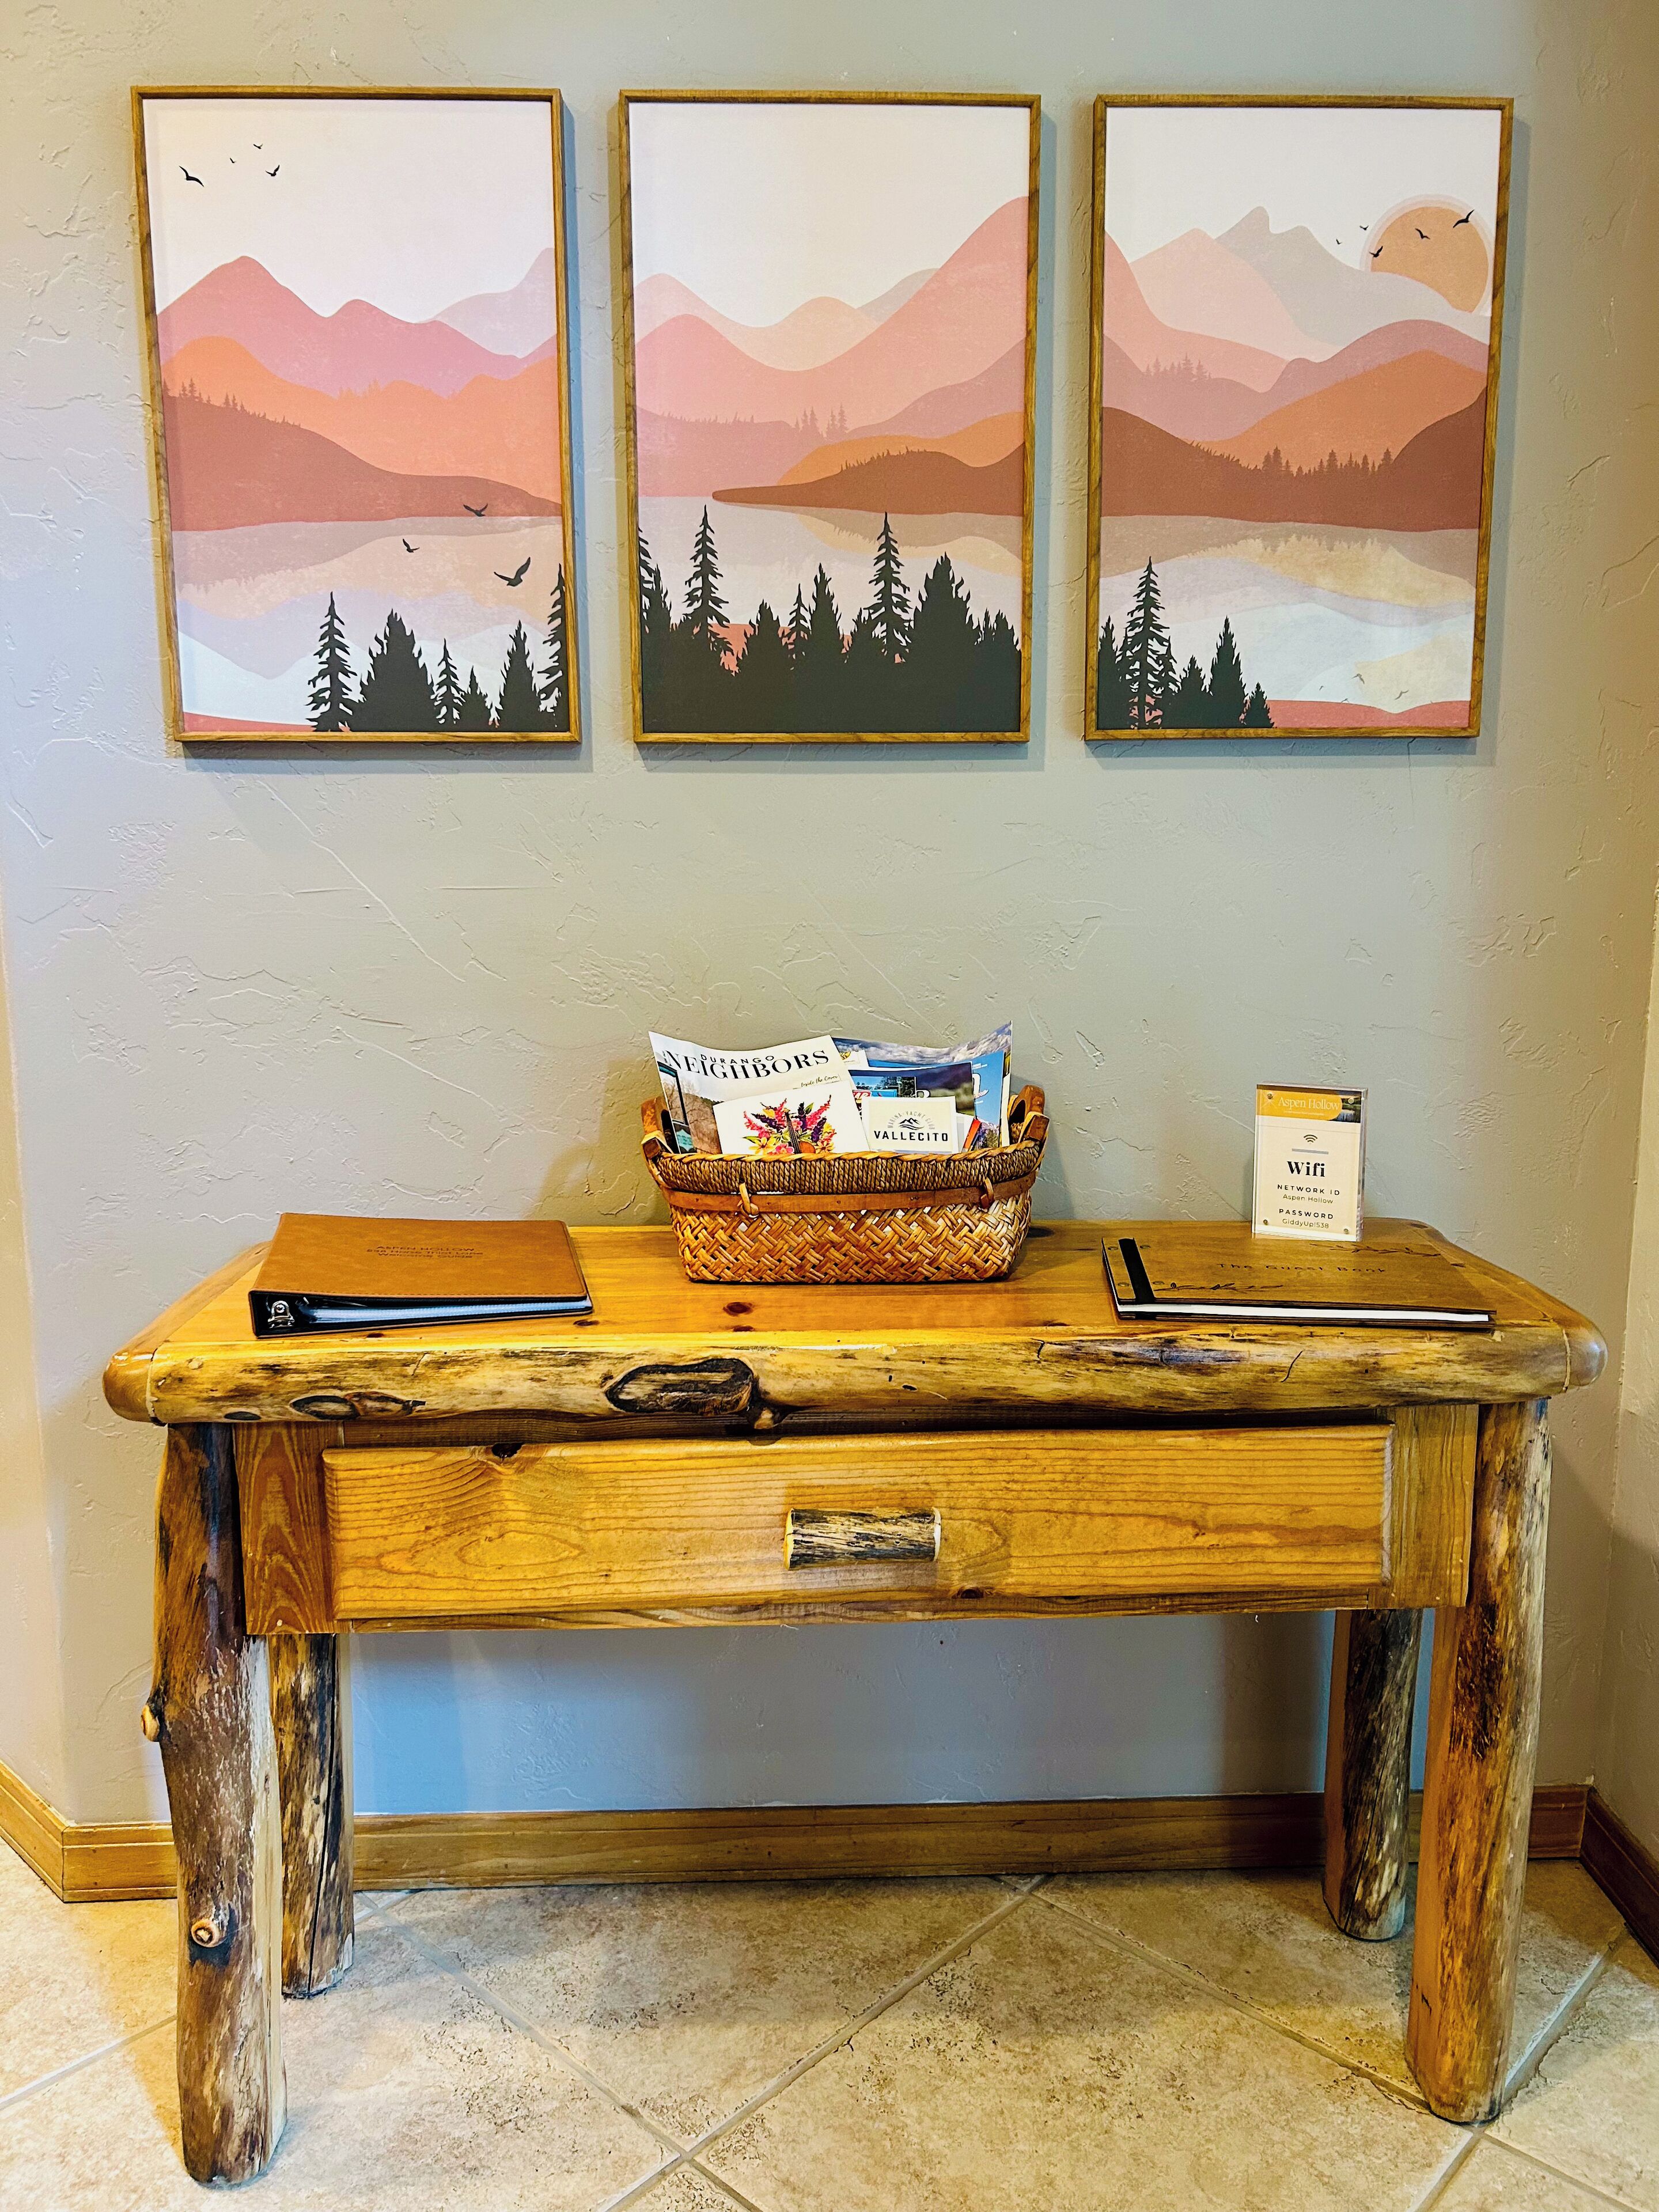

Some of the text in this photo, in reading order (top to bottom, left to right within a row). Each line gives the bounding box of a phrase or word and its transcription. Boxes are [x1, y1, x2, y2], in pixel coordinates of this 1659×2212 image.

[665, 1050, 829, 1079] NEIGHBORS
[700, 1054, 774, 1064] DURANGO
[1278, 1097, 1340, 1111] Aspen Hollow
[888, 1113, 902, 1128] MARINA
[874, 1130, 948, 1141] VALLECITO
[1287, 1161, 1325, 1177] Wifi
[1277, 1184, 1325, 1194] NETWORK
[1279, 1209, 1334, 1219] PASSWORD
